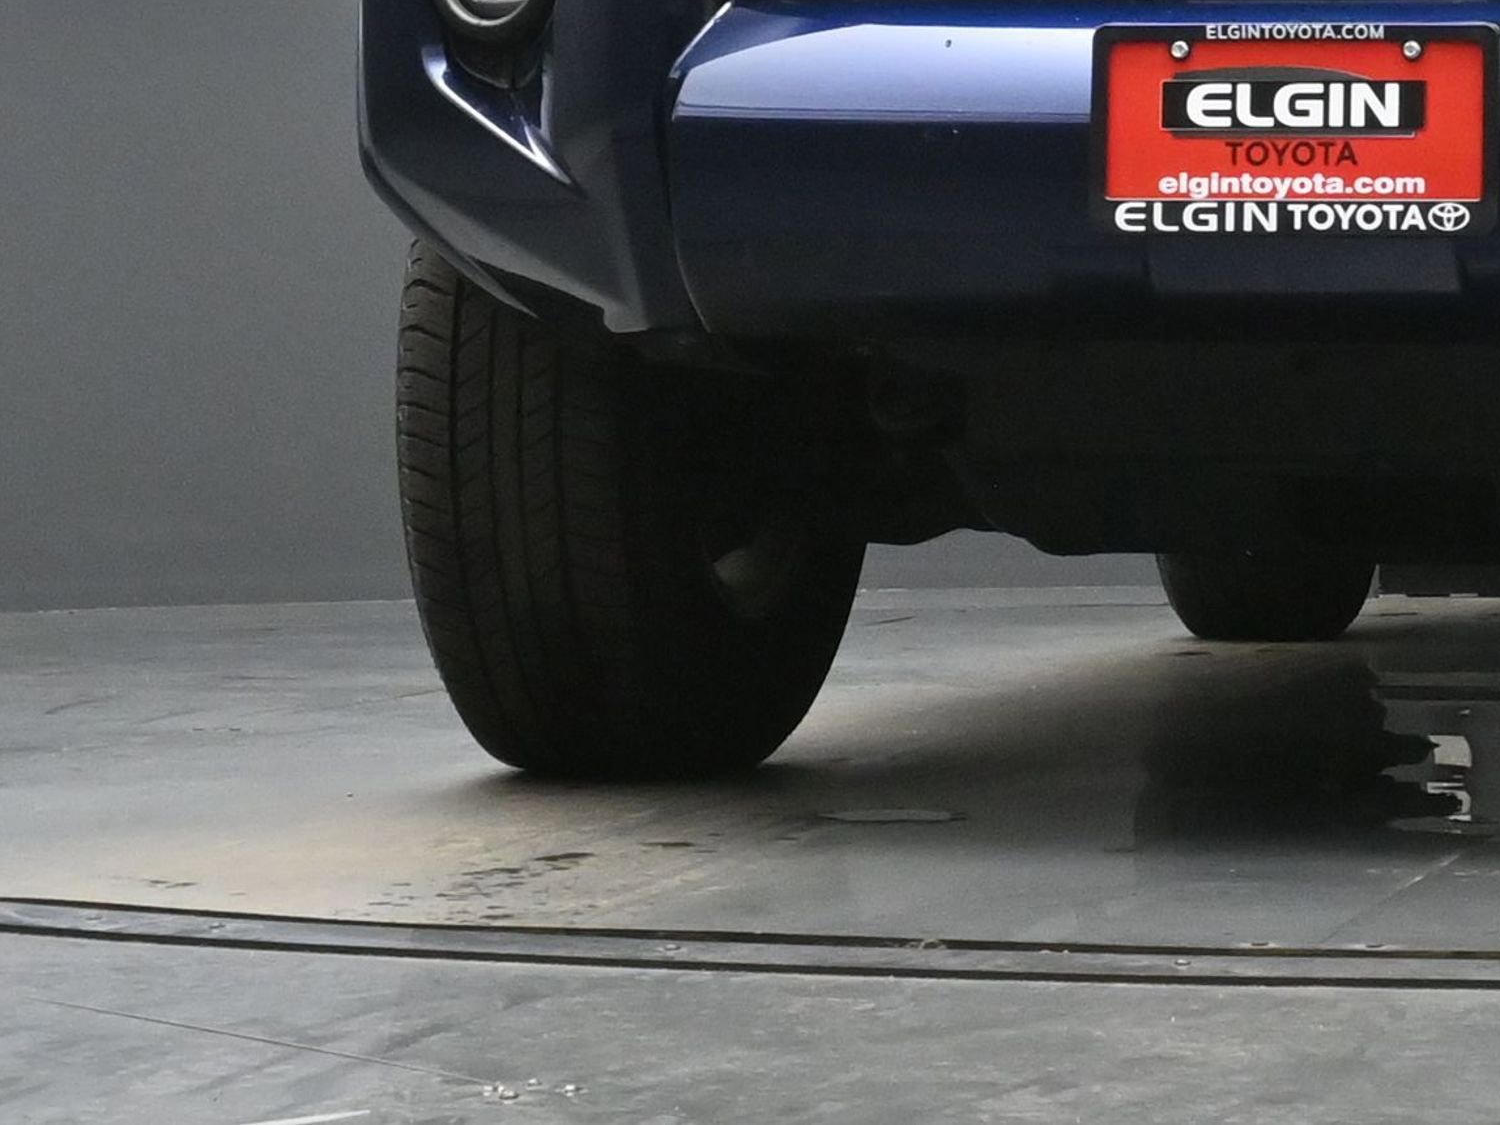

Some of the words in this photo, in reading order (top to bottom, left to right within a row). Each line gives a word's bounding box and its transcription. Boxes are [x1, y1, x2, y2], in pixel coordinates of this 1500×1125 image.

[1206, 24, 1384, 40] ELGINTOYOTA.COM
[1186, 83, 1400, 128] ELGIN
[1225, 141, 1358, 166] TOYOTA
[1158, 172, 1426, 199] elgintoyota.com
[1115, 202, 1278, 232] ELGIN
[1287, 204, 1427, 231] TOYOTA
